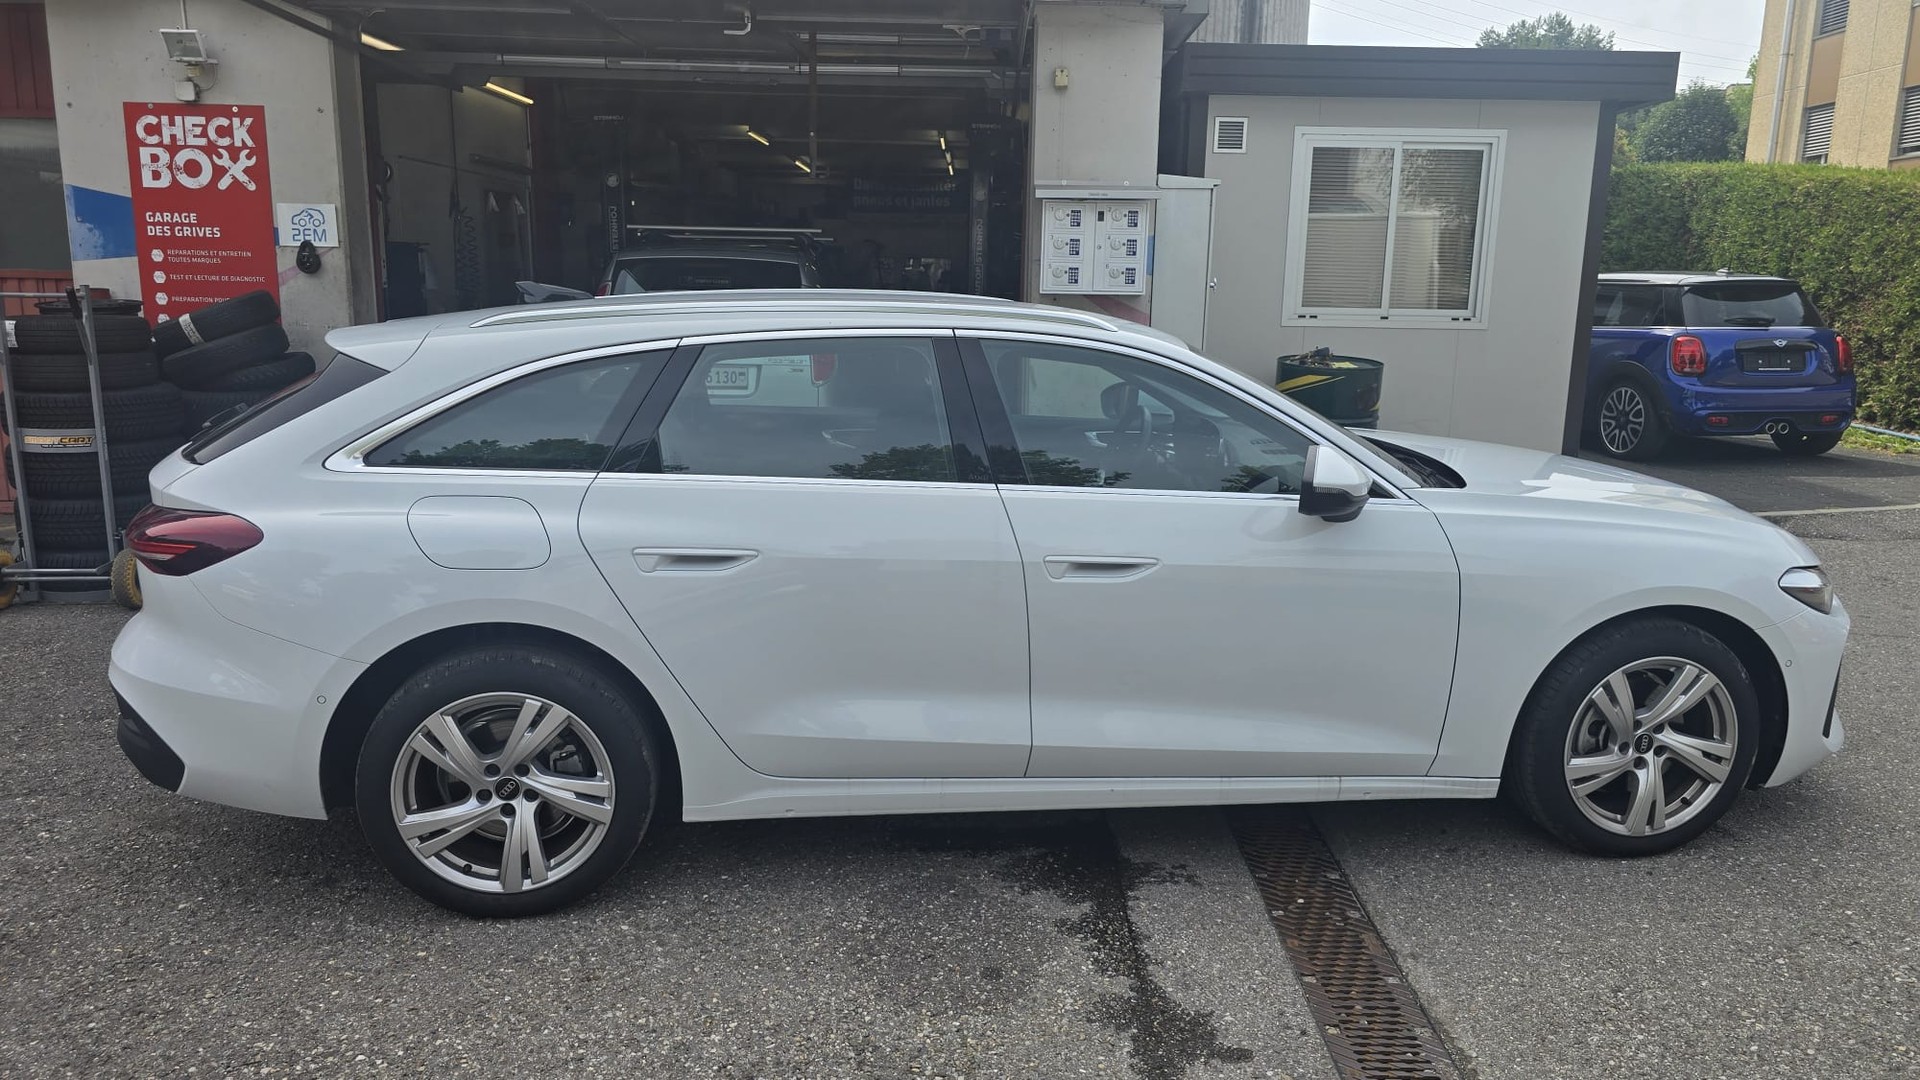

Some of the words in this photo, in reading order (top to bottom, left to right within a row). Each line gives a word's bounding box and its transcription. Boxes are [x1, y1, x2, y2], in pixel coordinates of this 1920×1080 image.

[136, 115, 257, 147] CHECK
[139, 147, 257, 191] BOX
[146, 212, 198, 224] GARAGE
[147, 226, 172, 237] DES
[175, 226, 221, 238] GRIVES
[218, 250, 252, 258] ENTRETIEN
[194, 274, 220, 282] LECTURE
[230, 275, 266, 283] DIAGNOSTIC
[715, 370, 738, 385] 130
